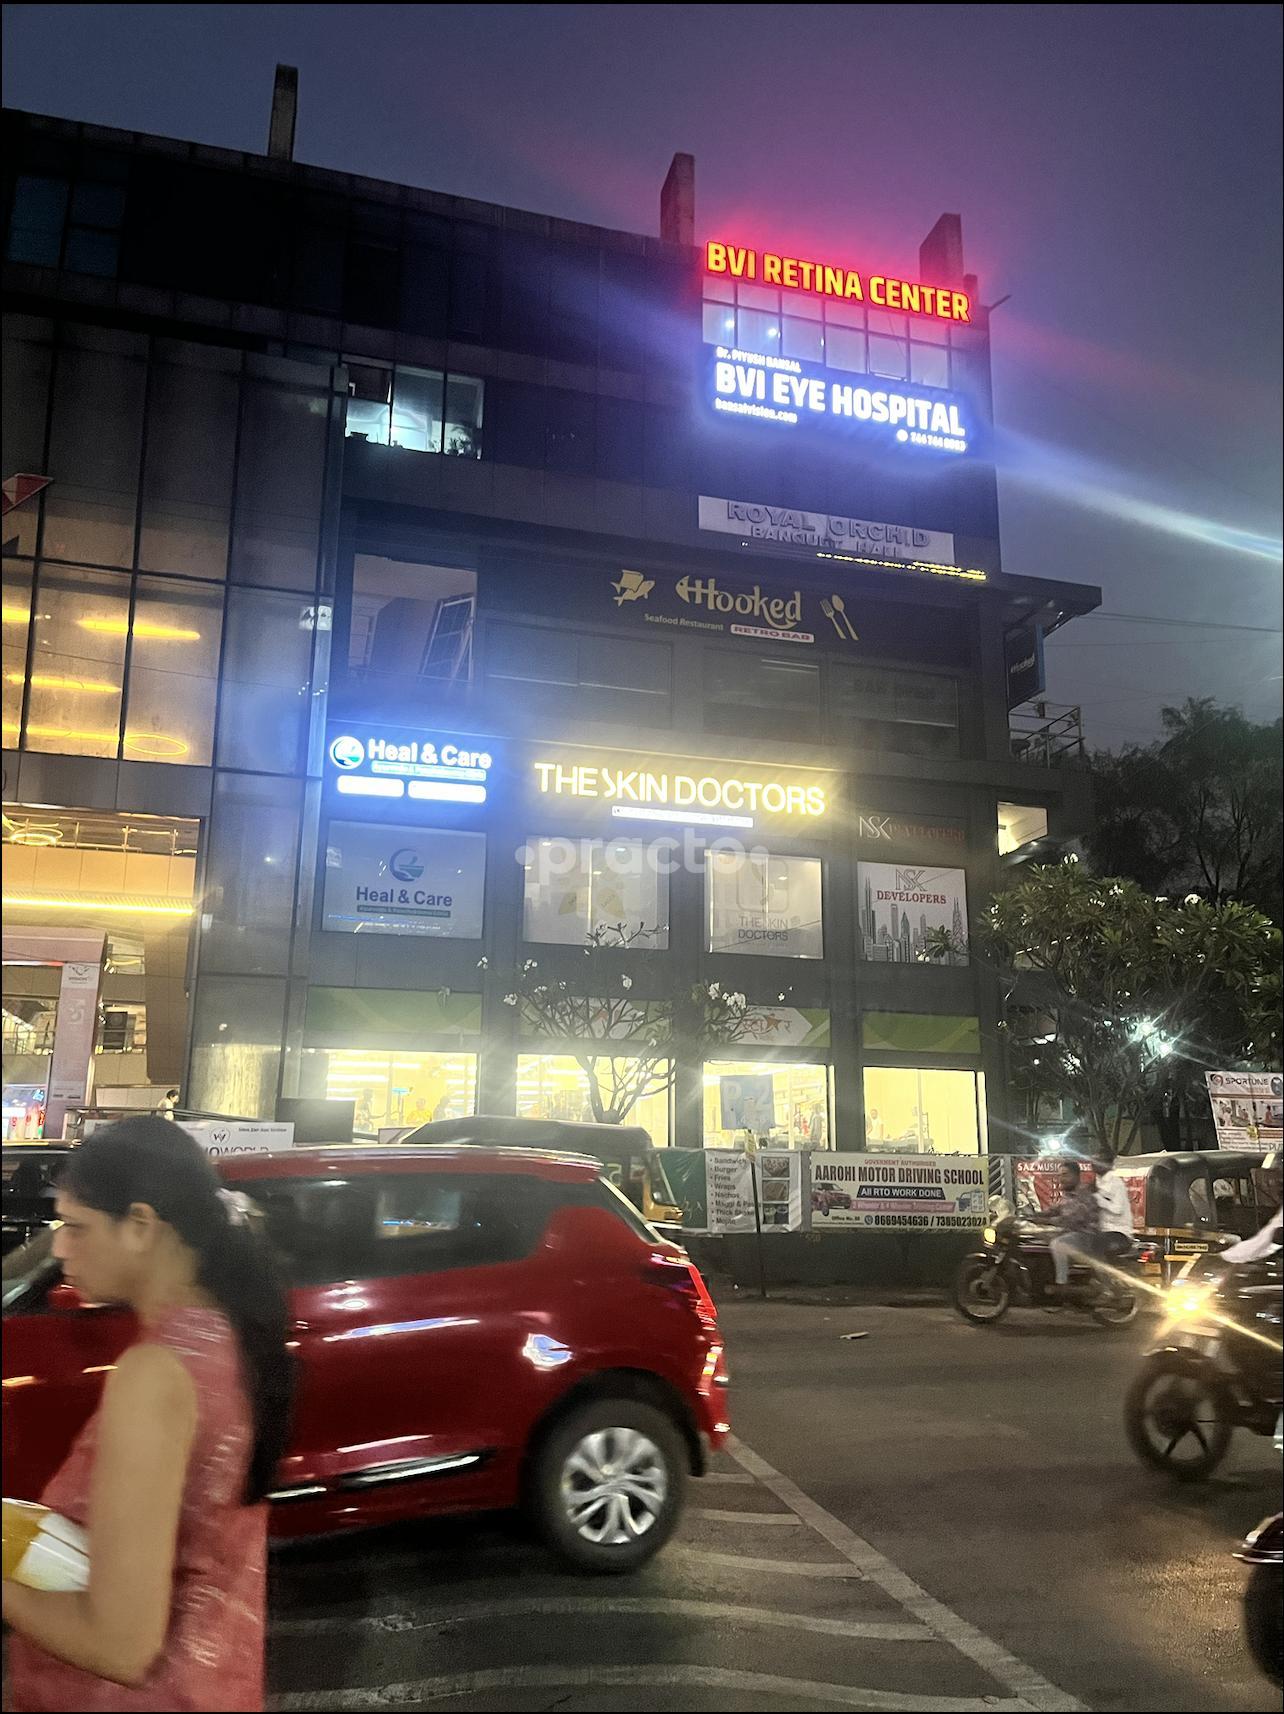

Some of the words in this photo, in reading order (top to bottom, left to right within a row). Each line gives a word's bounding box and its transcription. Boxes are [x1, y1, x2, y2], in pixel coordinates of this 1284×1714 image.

[706, 241, 756, 280] BVI
[763, 253, 864, 301] RETINA
[869, 276, 971, 323] CENTER
[716, 361, 766, 400] BVI
[773, 372, 826, 412] EYE
[831, 384, 966, 437] HOSPITAL
[727, 501, 816, 531] ROYAL
[828, 517, 930, 549] ORCHID
[678, 576, 802, 629] Hooked
[644, 613, 678, 625] Seafood
[680, 618, 724, 631] Restaurant
[734, 626, 780, 637] RETRO
[781, 632, 811, 641] BAR
[368, 738, 418, 763] Heal
[421, 743, 438, 765] &
[441, 745, 493, 769] Care
[534, 762, 598, 797] THE
[675, 776, 825, 817] DOCTORS
[356, 886, 393, 903] Heal
[398, 889, 410, 904] &
[414, 891, 453, 907] Care
[876, 890, 947, 905] DEVELOPERS
[738, 929, 789, 941] DOCTORS
[815, 1165, 855, 1181] AAROHI
[858, 1166, 896, 1182] MOTOR
[898, 1167, 941, 1184] DRIVING
[943, 1168, 985, 1185] SCHOOL
[861, 1188, 872, 1196] All
[873, 1188, 890, 1196] RTO
[891, 1188, 917, 1197] WORK
[918, 1189, 942, 1198] DONE
